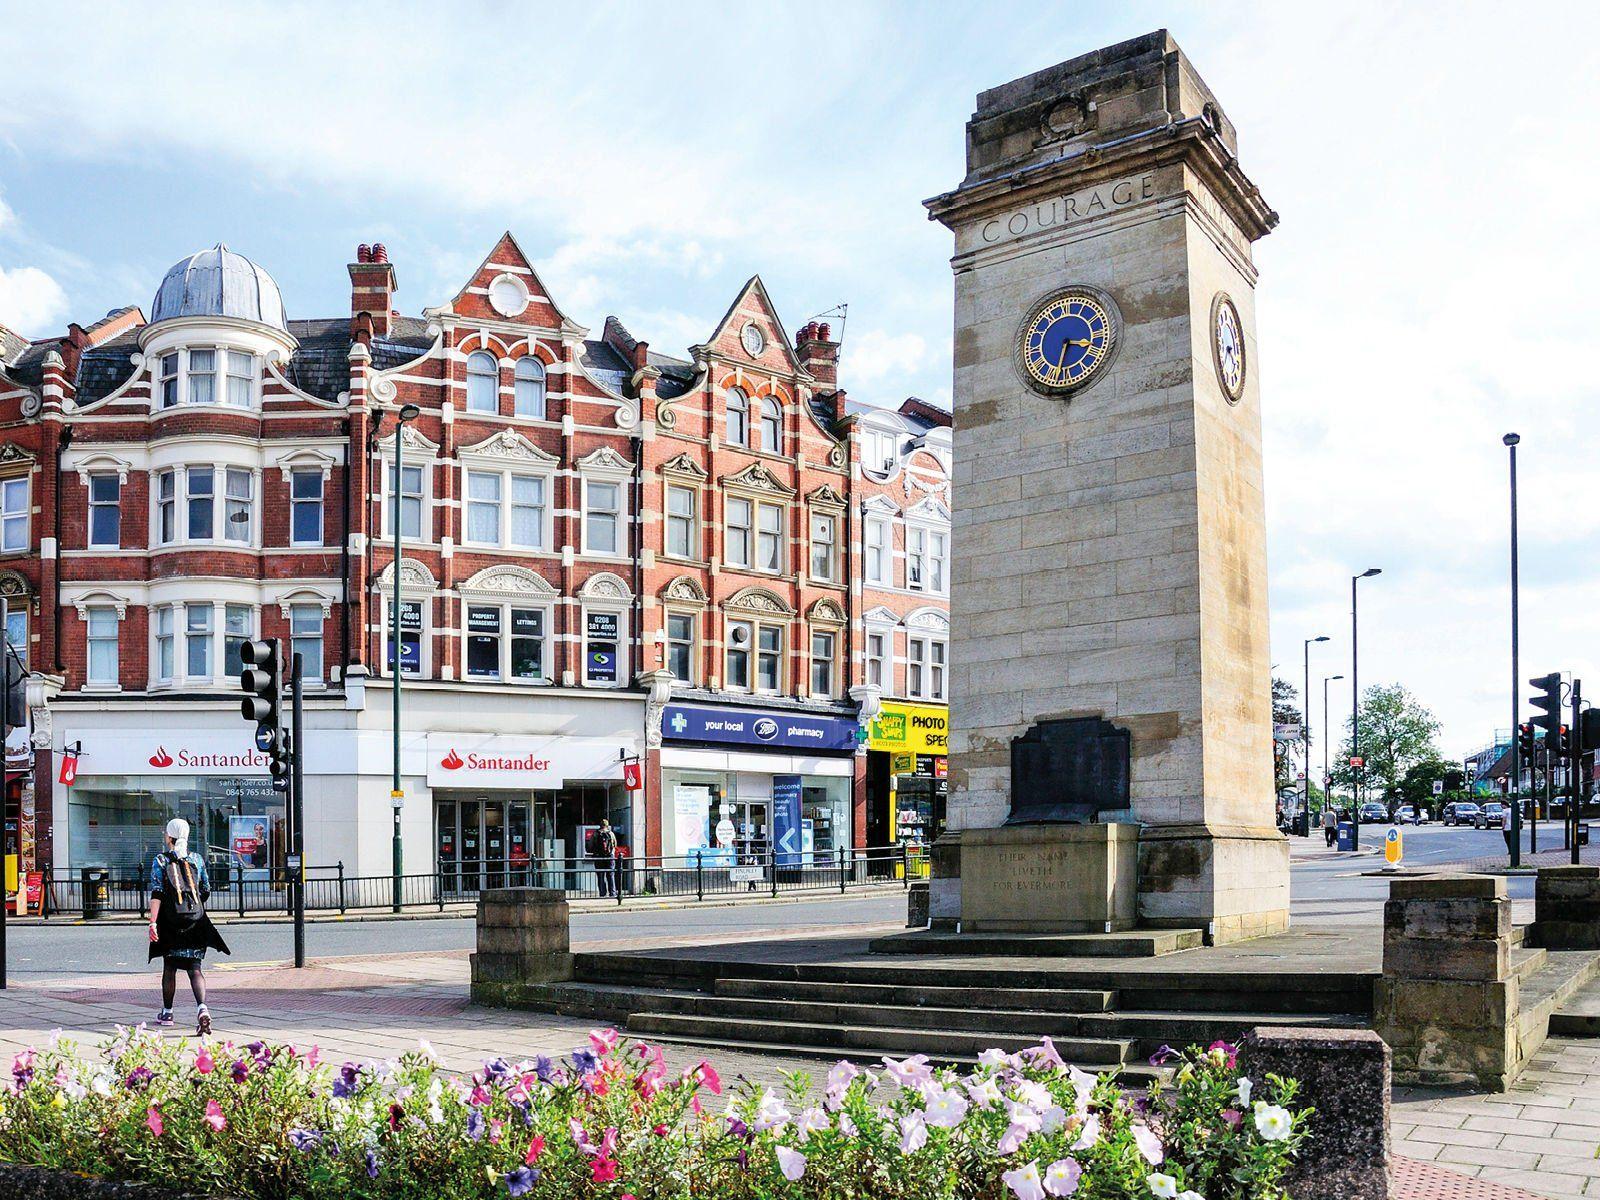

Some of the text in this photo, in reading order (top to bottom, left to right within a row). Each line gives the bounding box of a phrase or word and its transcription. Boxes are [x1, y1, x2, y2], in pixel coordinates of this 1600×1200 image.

[982, 175, 1155, 243] COURAGE
[705, 720, 744, 732] your local
[912, 716, 945, 730] PHOTO
[788, 726, 824, 738] pharmacy
[178, 749, 273, 767] Santander
[468, 753, 551, 771] Santander
[218, 778, 274, 788] santander.co.u
